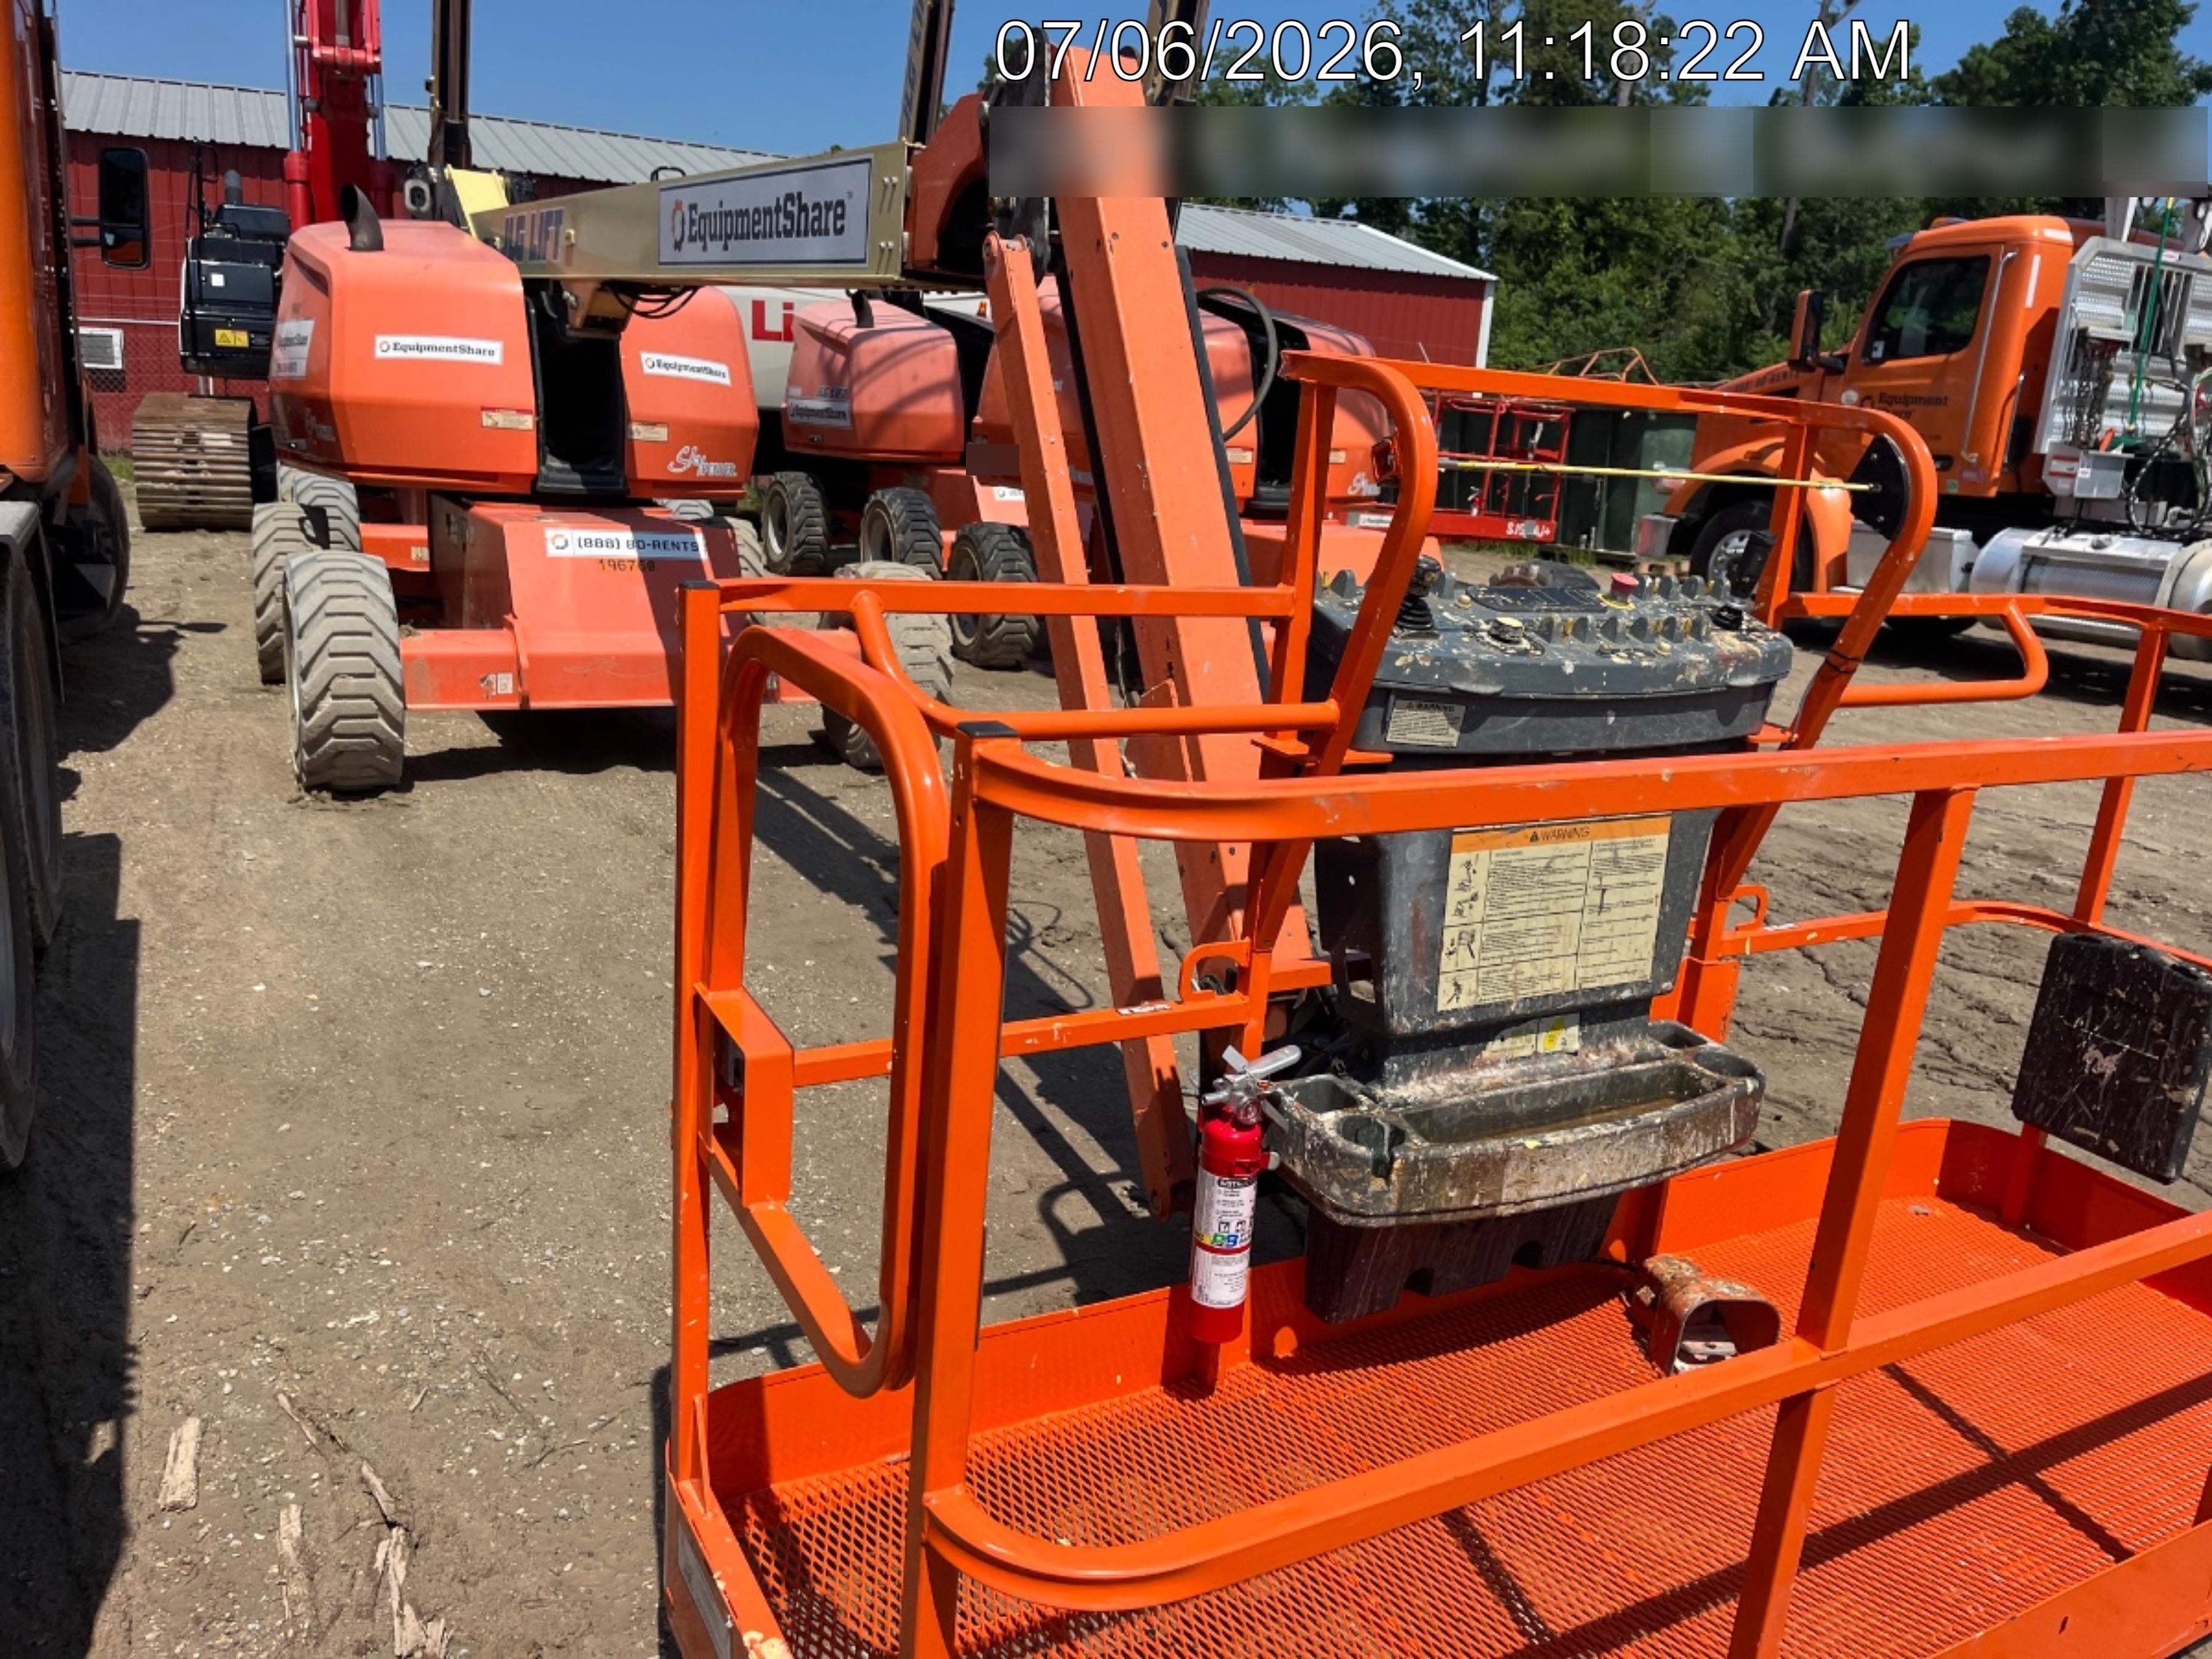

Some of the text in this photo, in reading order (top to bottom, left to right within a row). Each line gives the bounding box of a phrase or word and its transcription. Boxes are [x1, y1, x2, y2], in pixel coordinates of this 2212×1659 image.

[688, 191, 845, 253] EquipmentShare
[751, 300, 794, 342] Li
[393, 342, 495, 357] EquipmentShare
[1878, 392, 1948, 408] Equipment
[578, 537, 621, 549] (888)
